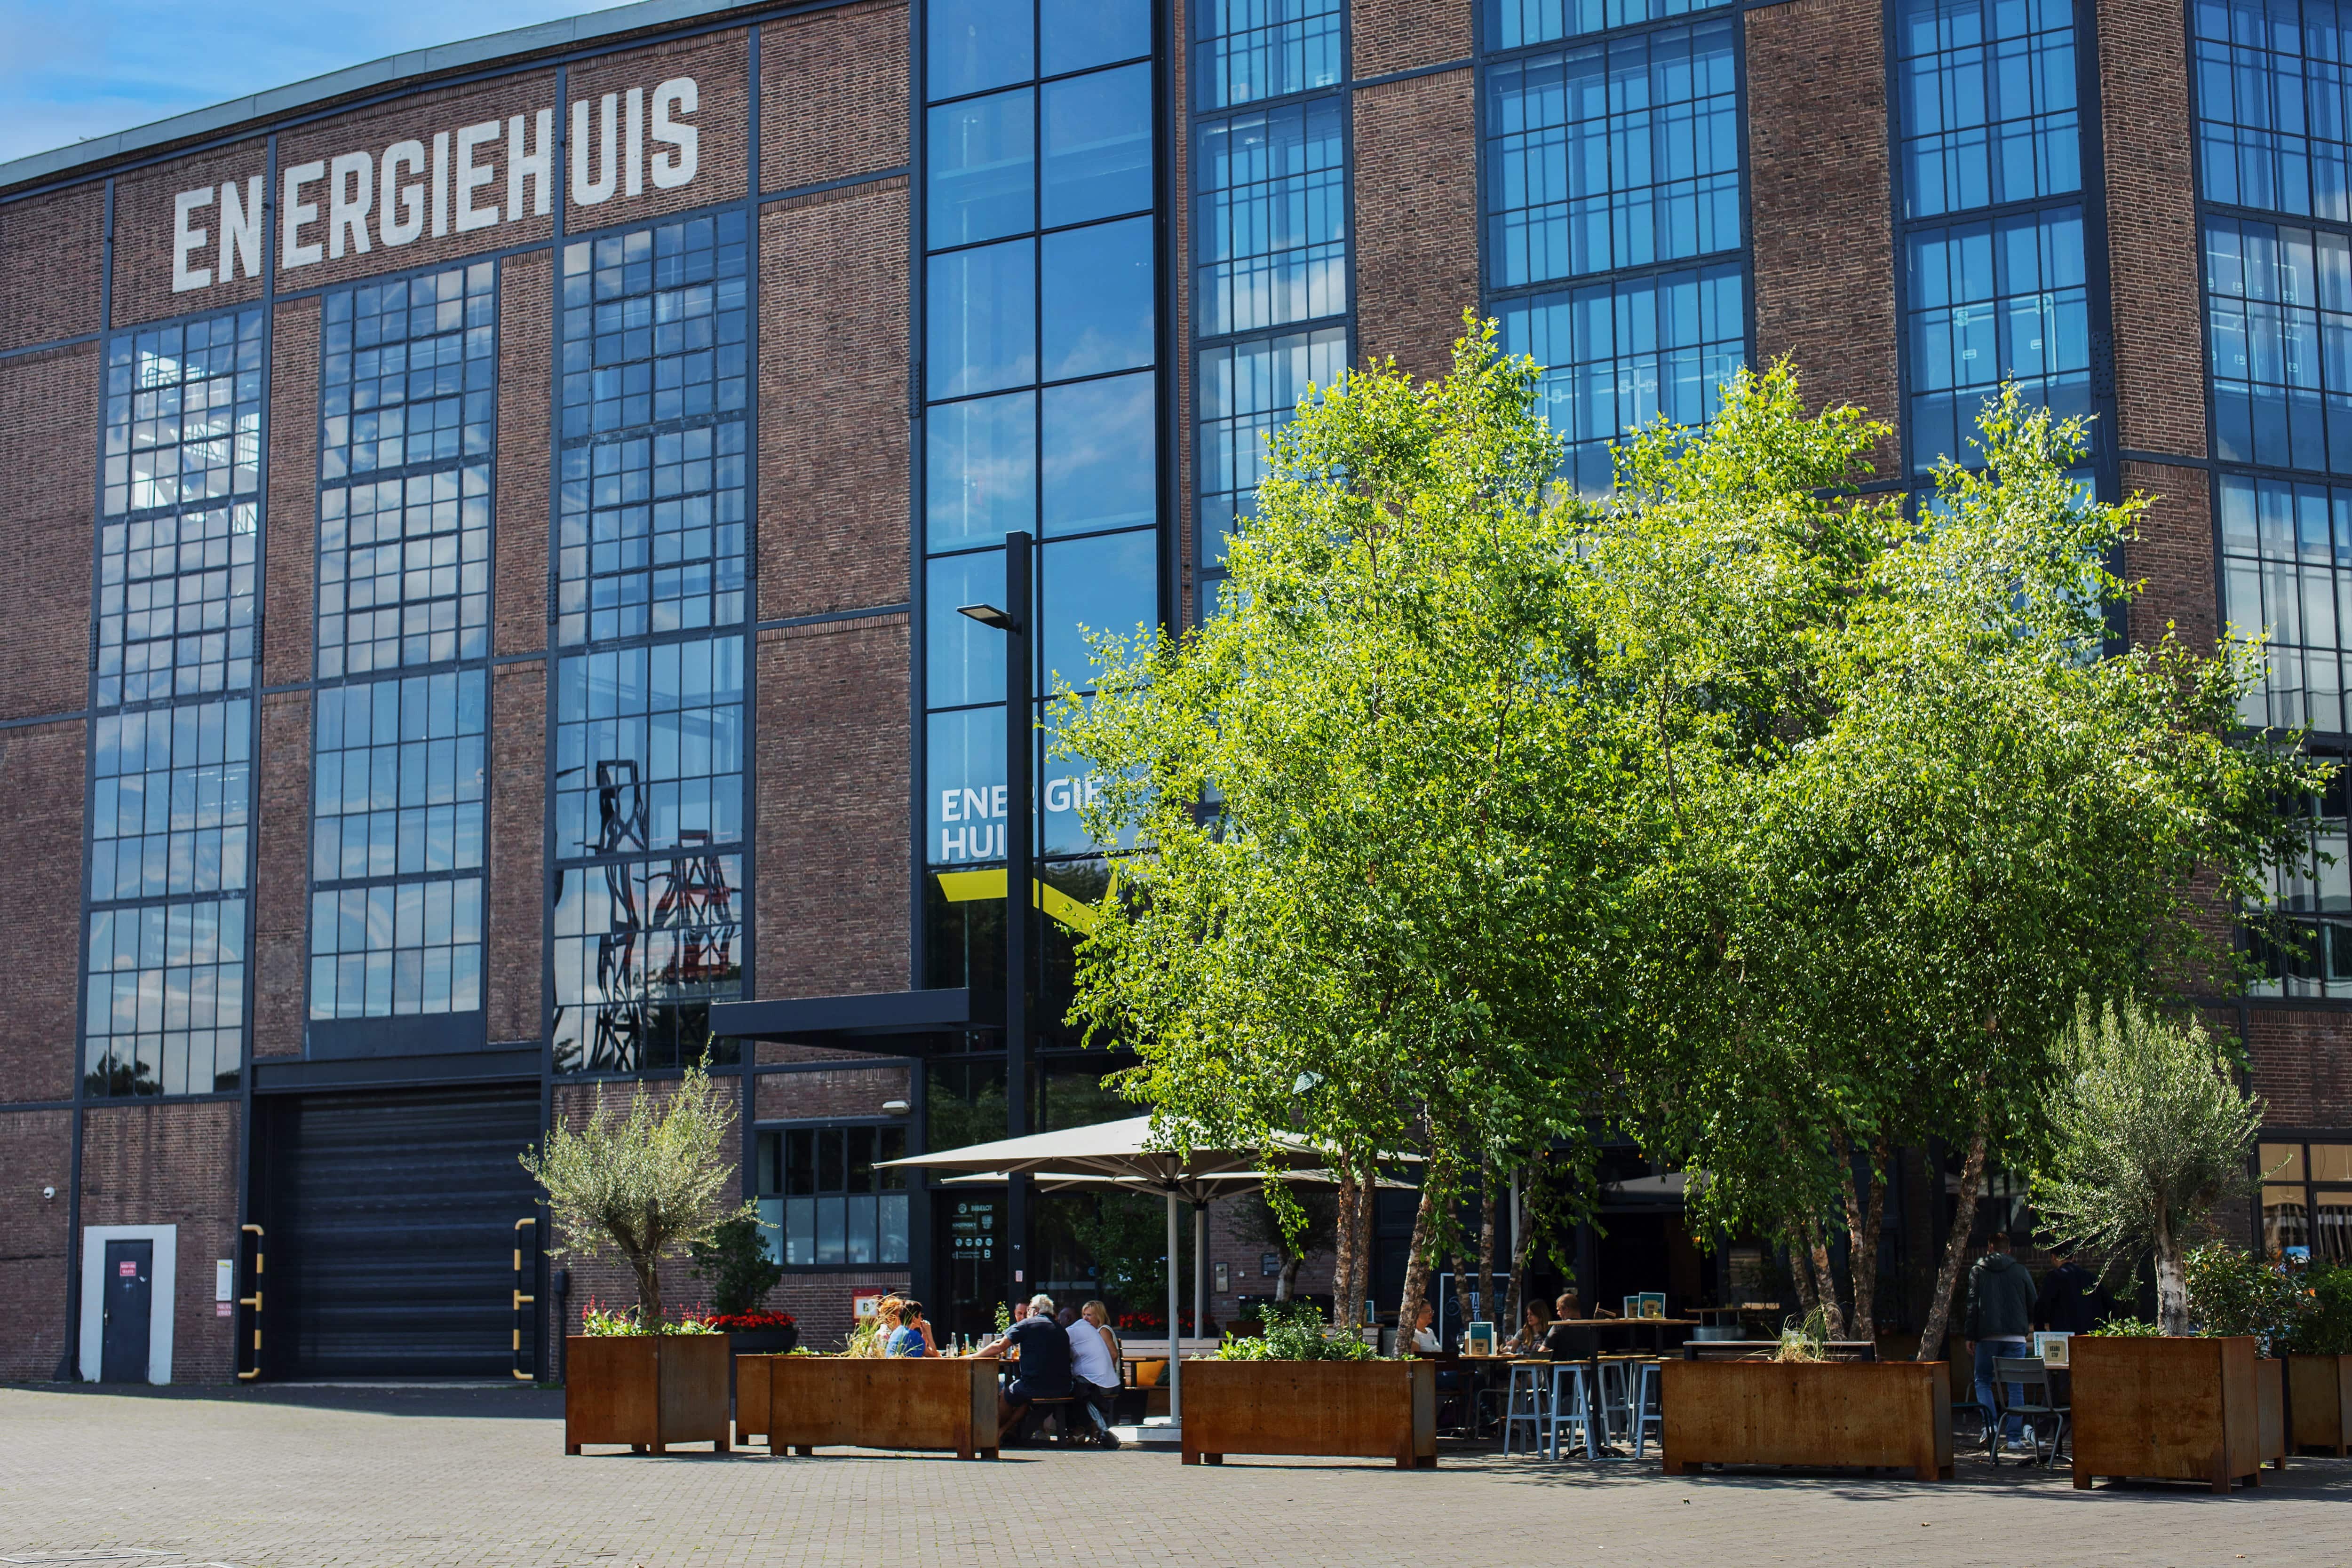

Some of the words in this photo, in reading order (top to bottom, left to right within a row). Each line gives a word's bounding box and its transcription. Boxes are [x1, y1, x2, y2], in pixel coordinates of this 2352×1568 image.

[172, 76, 699, 293] ENERGIEHUIS
[942, 776, 1105, 822] ENEGIE
[942, 824, 1007, 860] HUI
